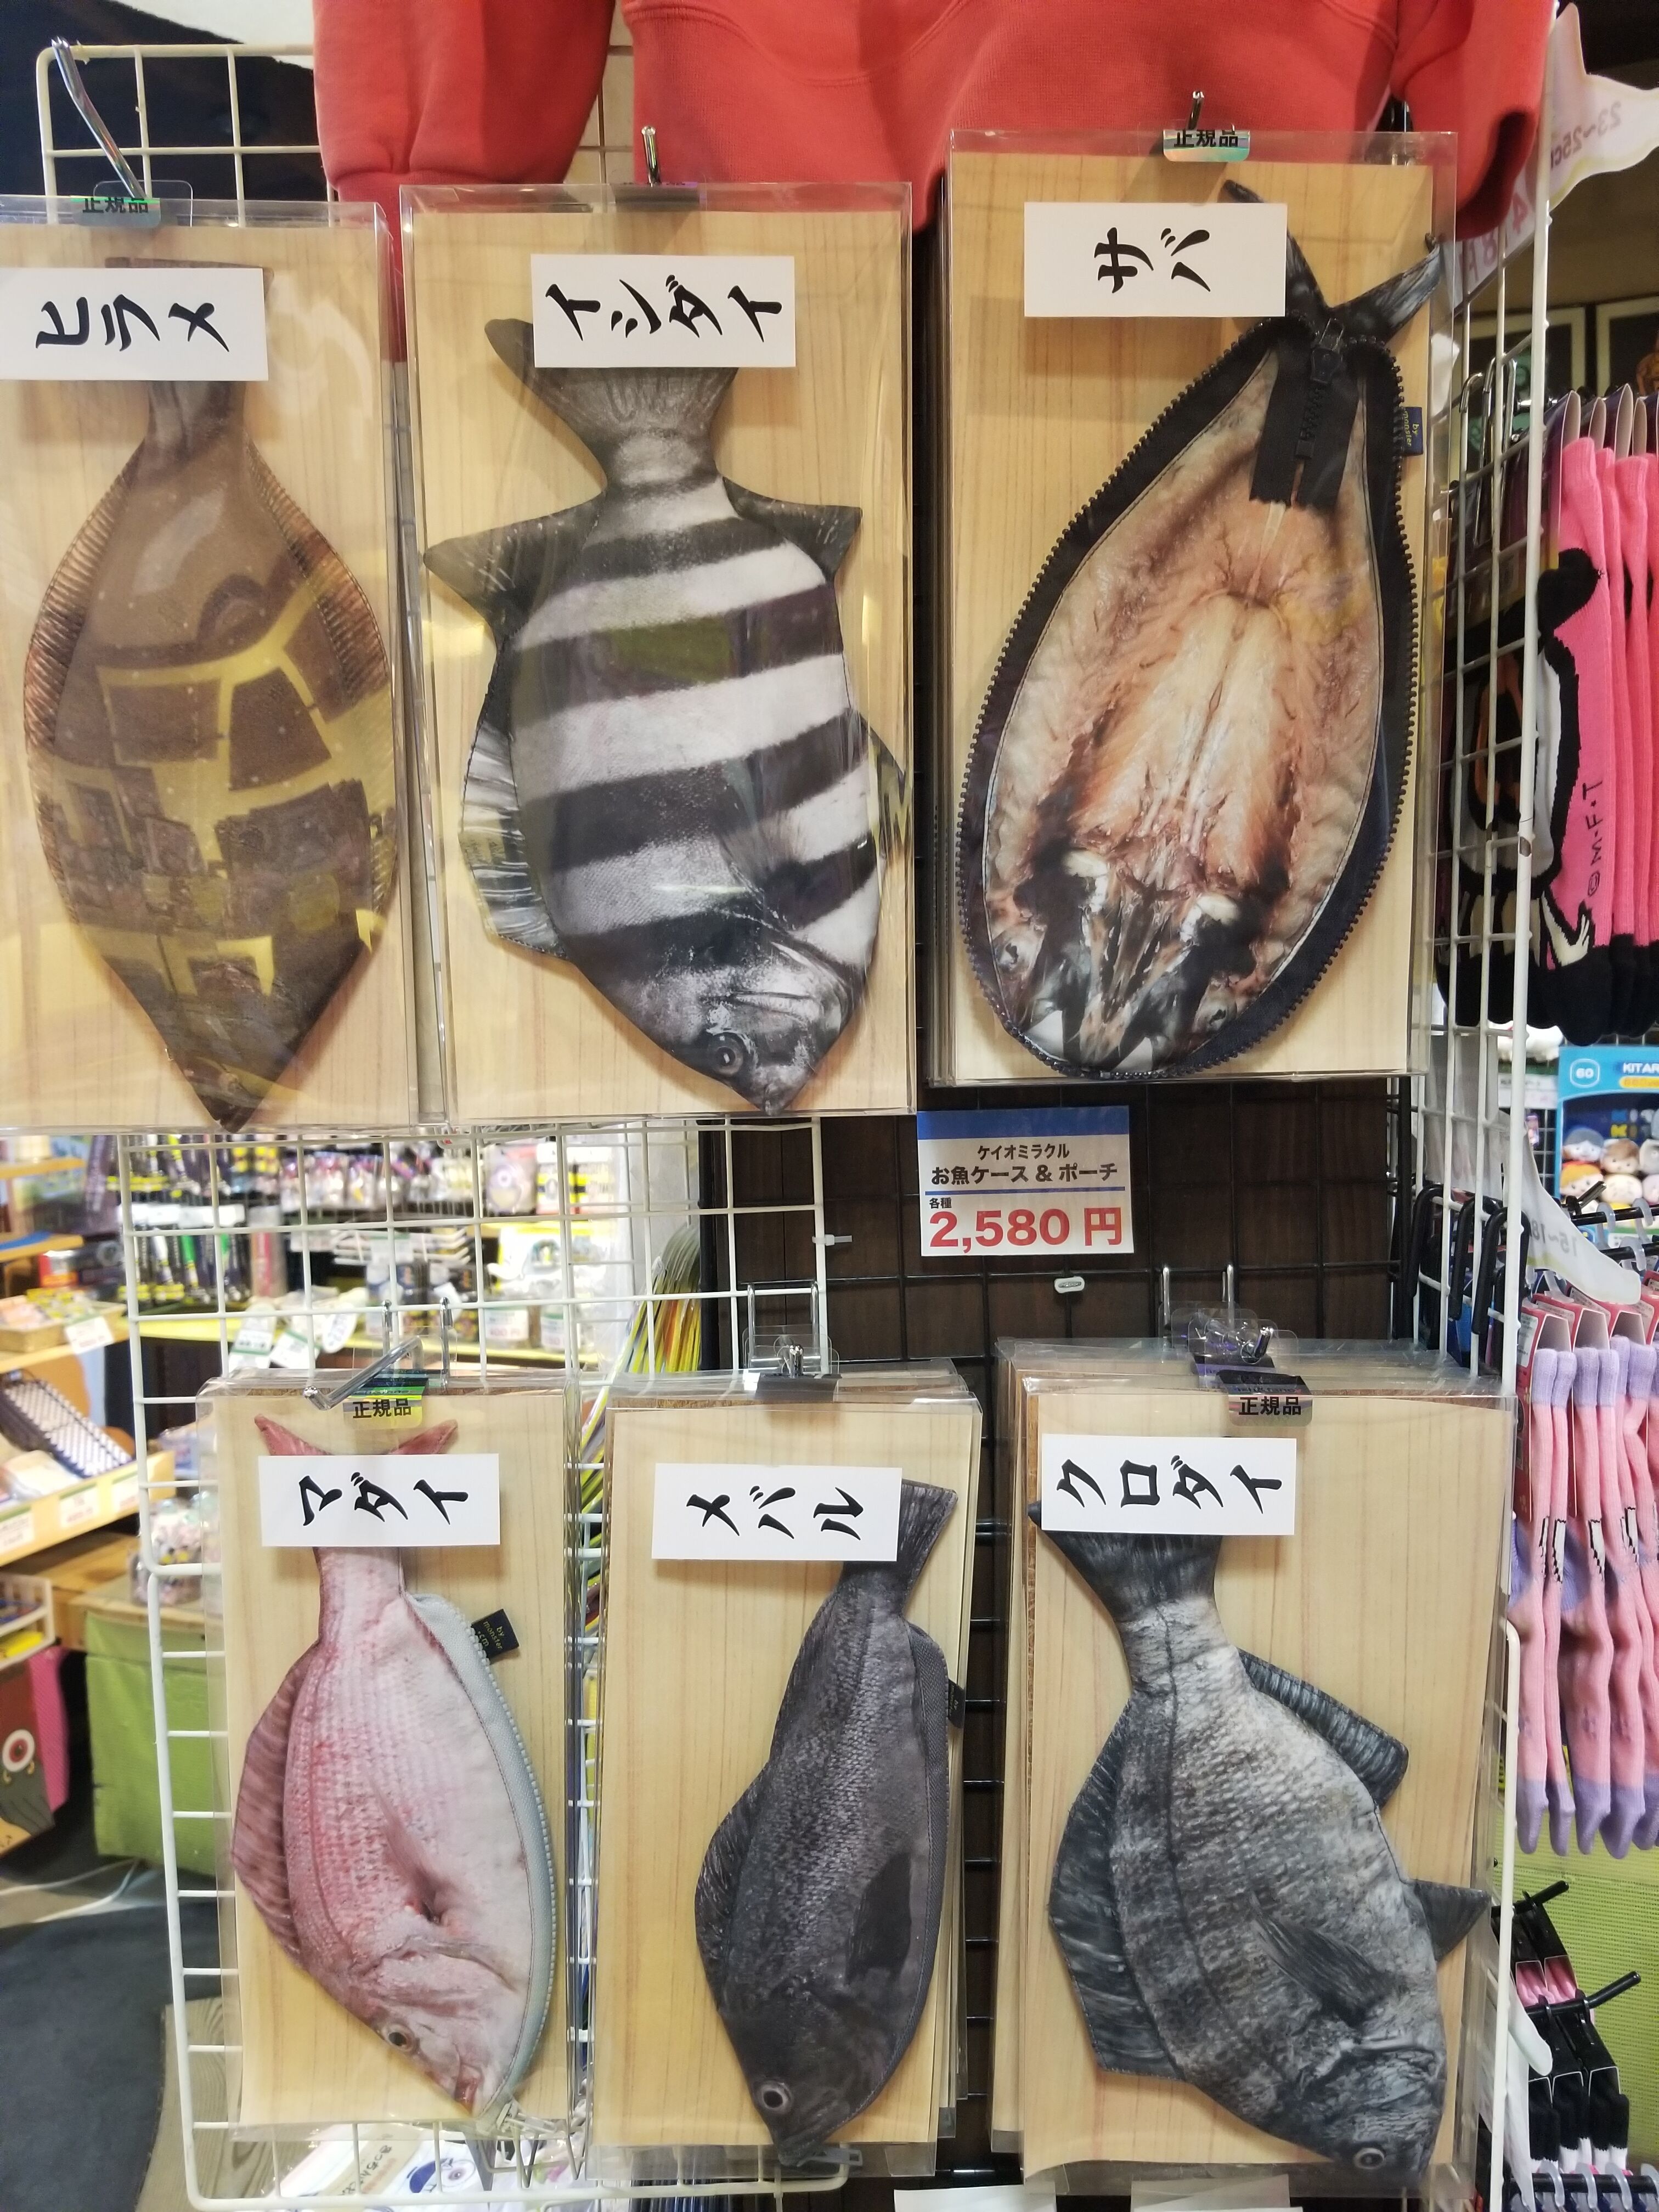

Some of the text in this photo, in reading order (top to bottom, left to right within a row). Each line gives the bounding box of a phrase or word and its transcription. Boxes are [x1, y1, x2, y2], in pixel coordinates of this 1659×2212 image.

[1174, 129, 1238, 148] 正規品
[1094, 227, 1211, 294] サバ
[545, 274, 782, 342] イシダイ
[36, 294, 229, 352] ヒラメ
[977, 1143, 1070, 1161] ケイオミラクル
[929, 1197, 952, 1209] 各種
[352, 1398, 412, 1419] 正規品
[1238, 1396, 1301, 1416] 正規品
[1057, 1455, 1282, 1514] クロダイ
[298, 1472, 469, 1526] マダイ
[686, 1486, 864, 1541] メバル
[483, 1621, 503, 1649] monster
[496, 1626, 505, 1637] by
